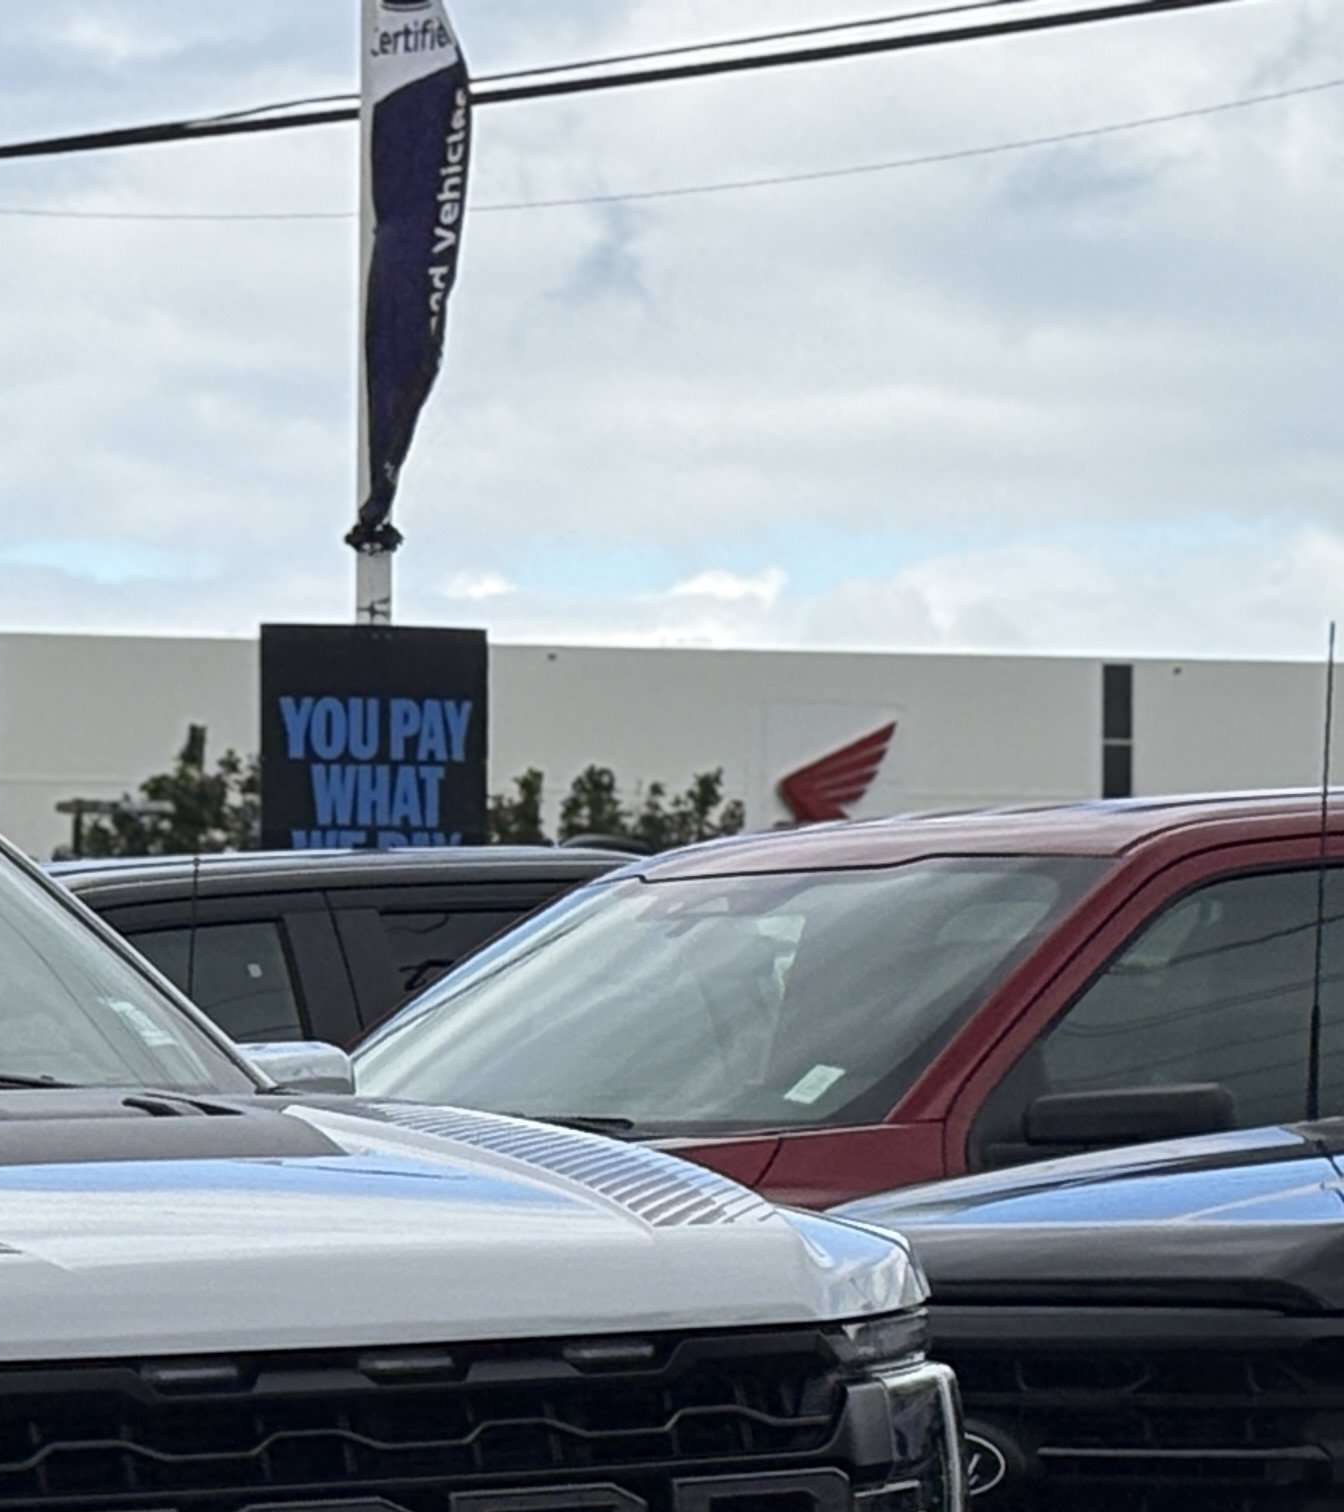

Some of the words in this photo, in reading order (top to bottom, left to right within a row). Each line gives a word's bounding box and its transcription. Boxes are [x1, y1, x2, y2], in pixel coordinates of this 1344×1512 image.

[279, 696, 380, 761] YOU
[389, 698, 474, 762] PAY
[310, 763, 445, 828] WHAT
